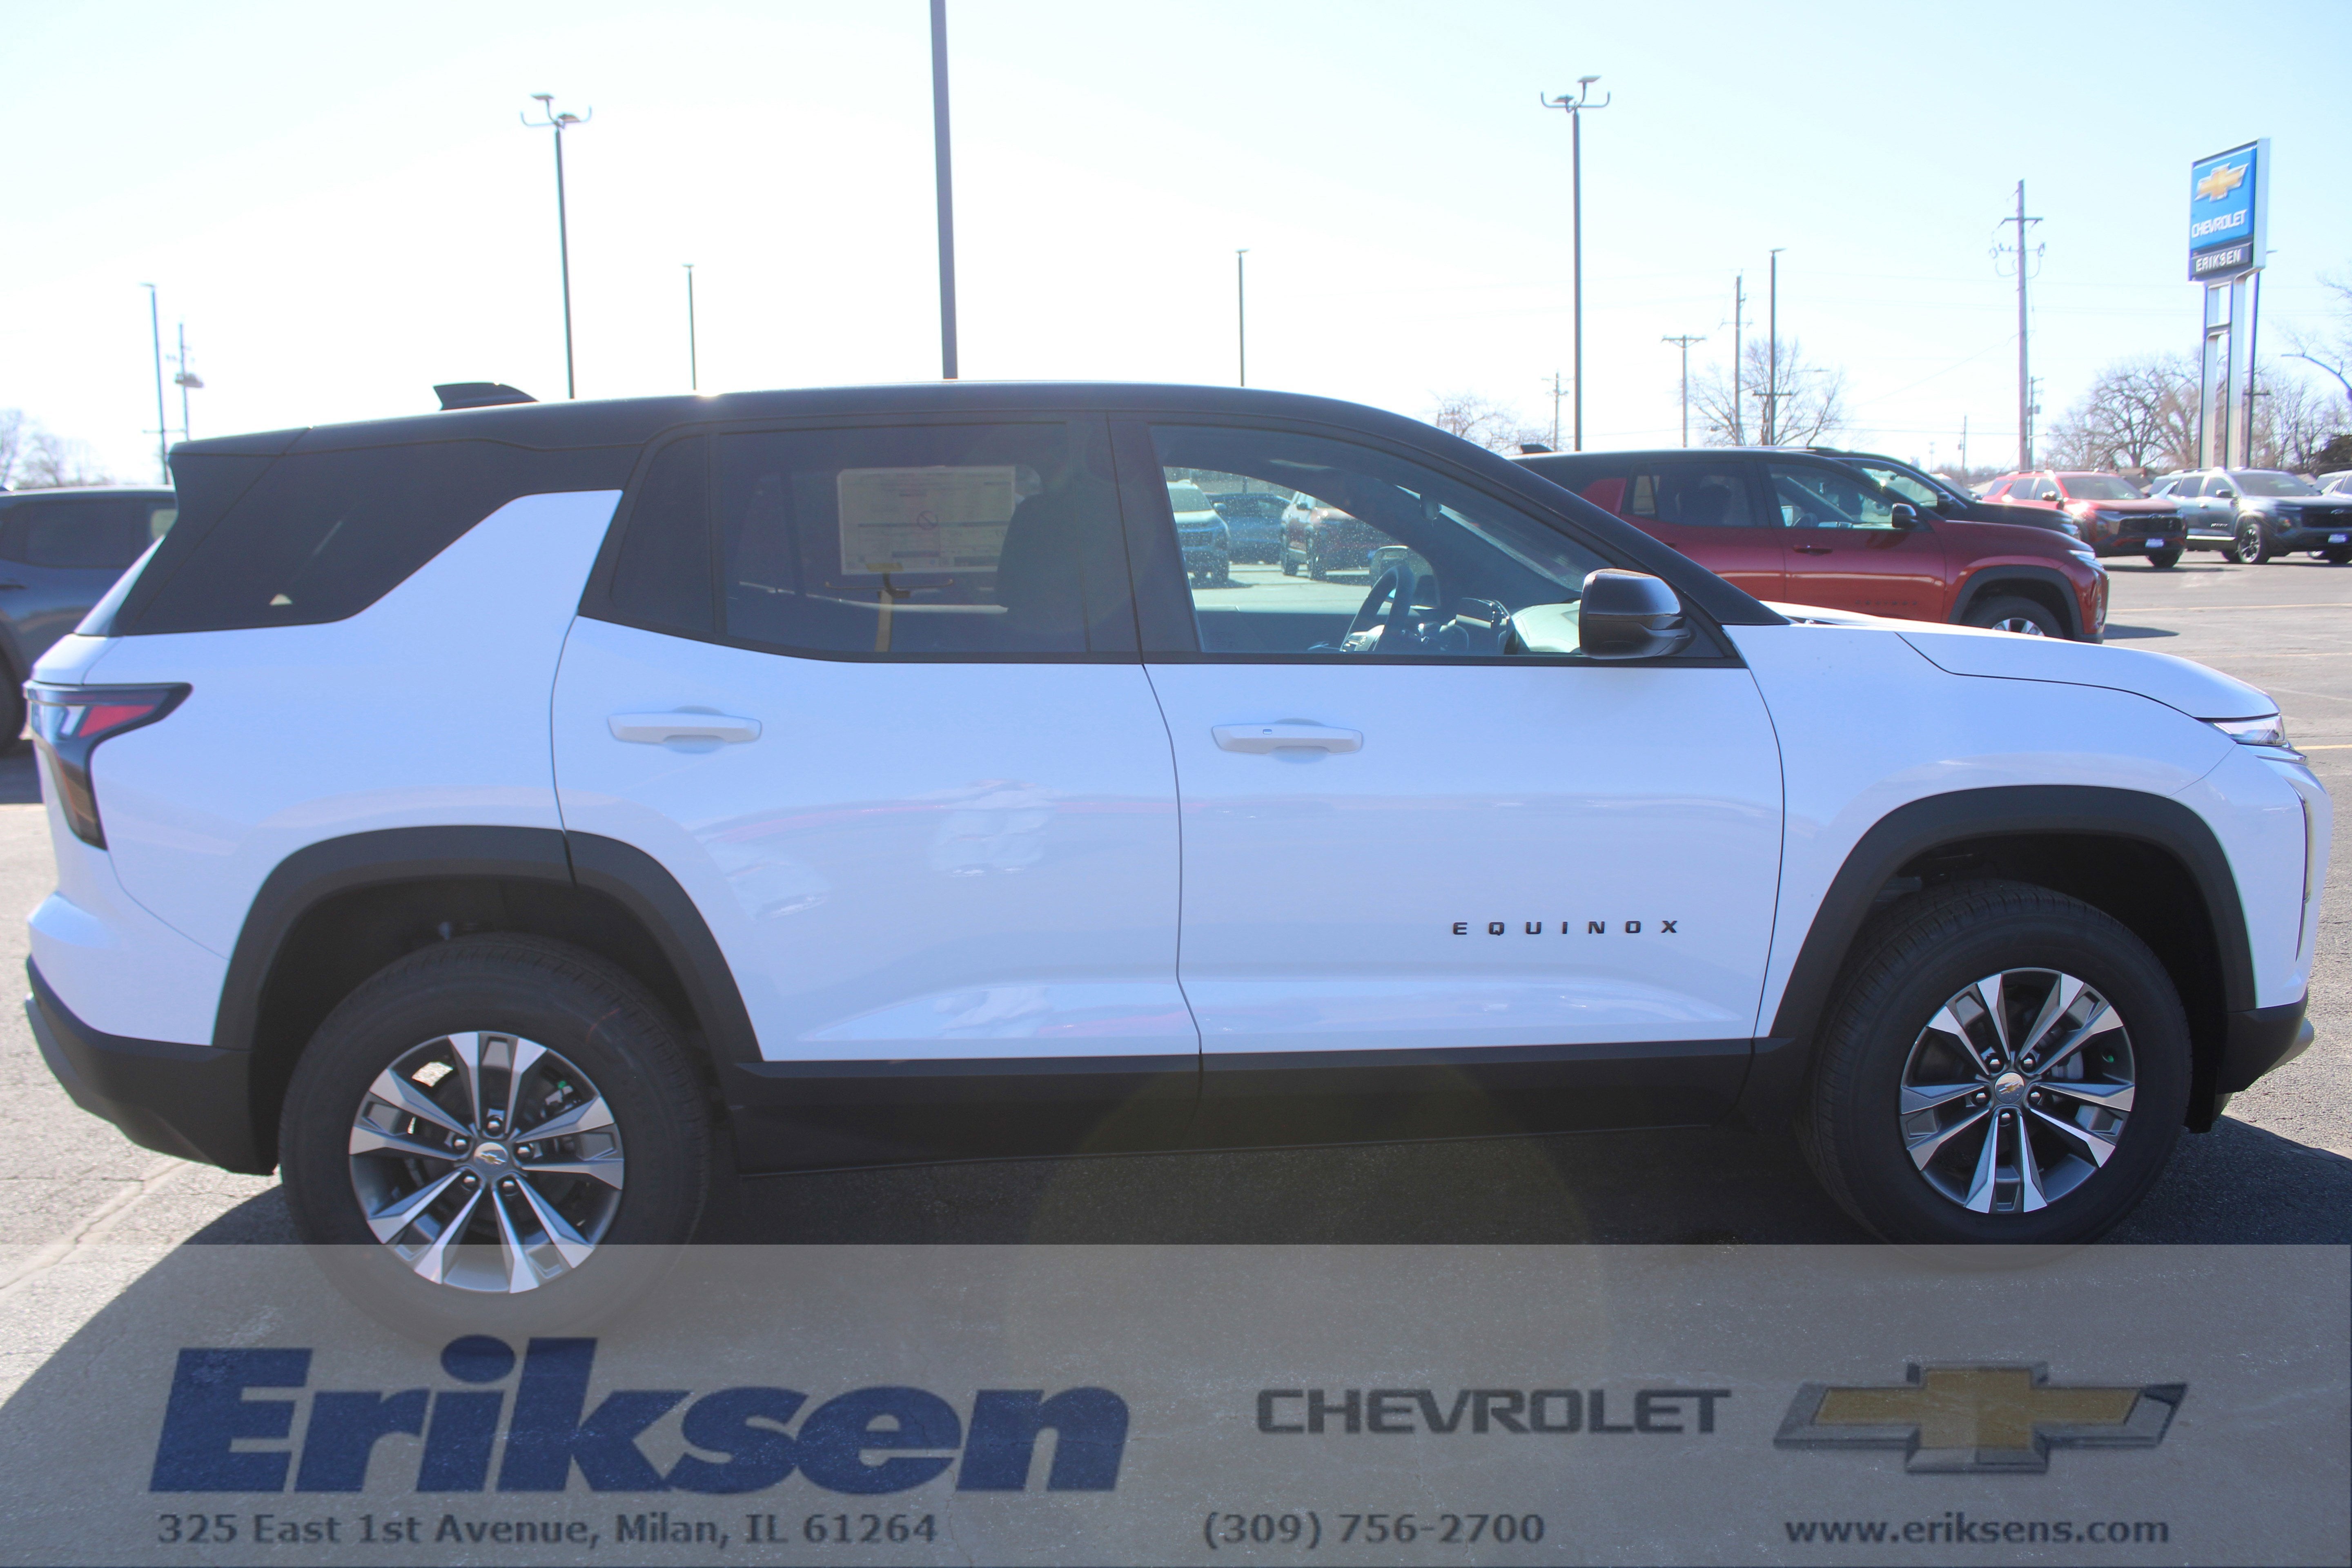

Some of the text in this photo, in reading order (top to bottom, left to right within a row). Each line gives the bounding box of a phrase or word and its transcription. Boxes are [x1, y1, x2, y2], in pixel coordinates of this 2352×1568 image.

[2191, 209, 2247, 238] CHEVROLET
[2195, 249, 2242, 272] ERIKSEN
[1452, 920, 1678, 936] EQUINOX
